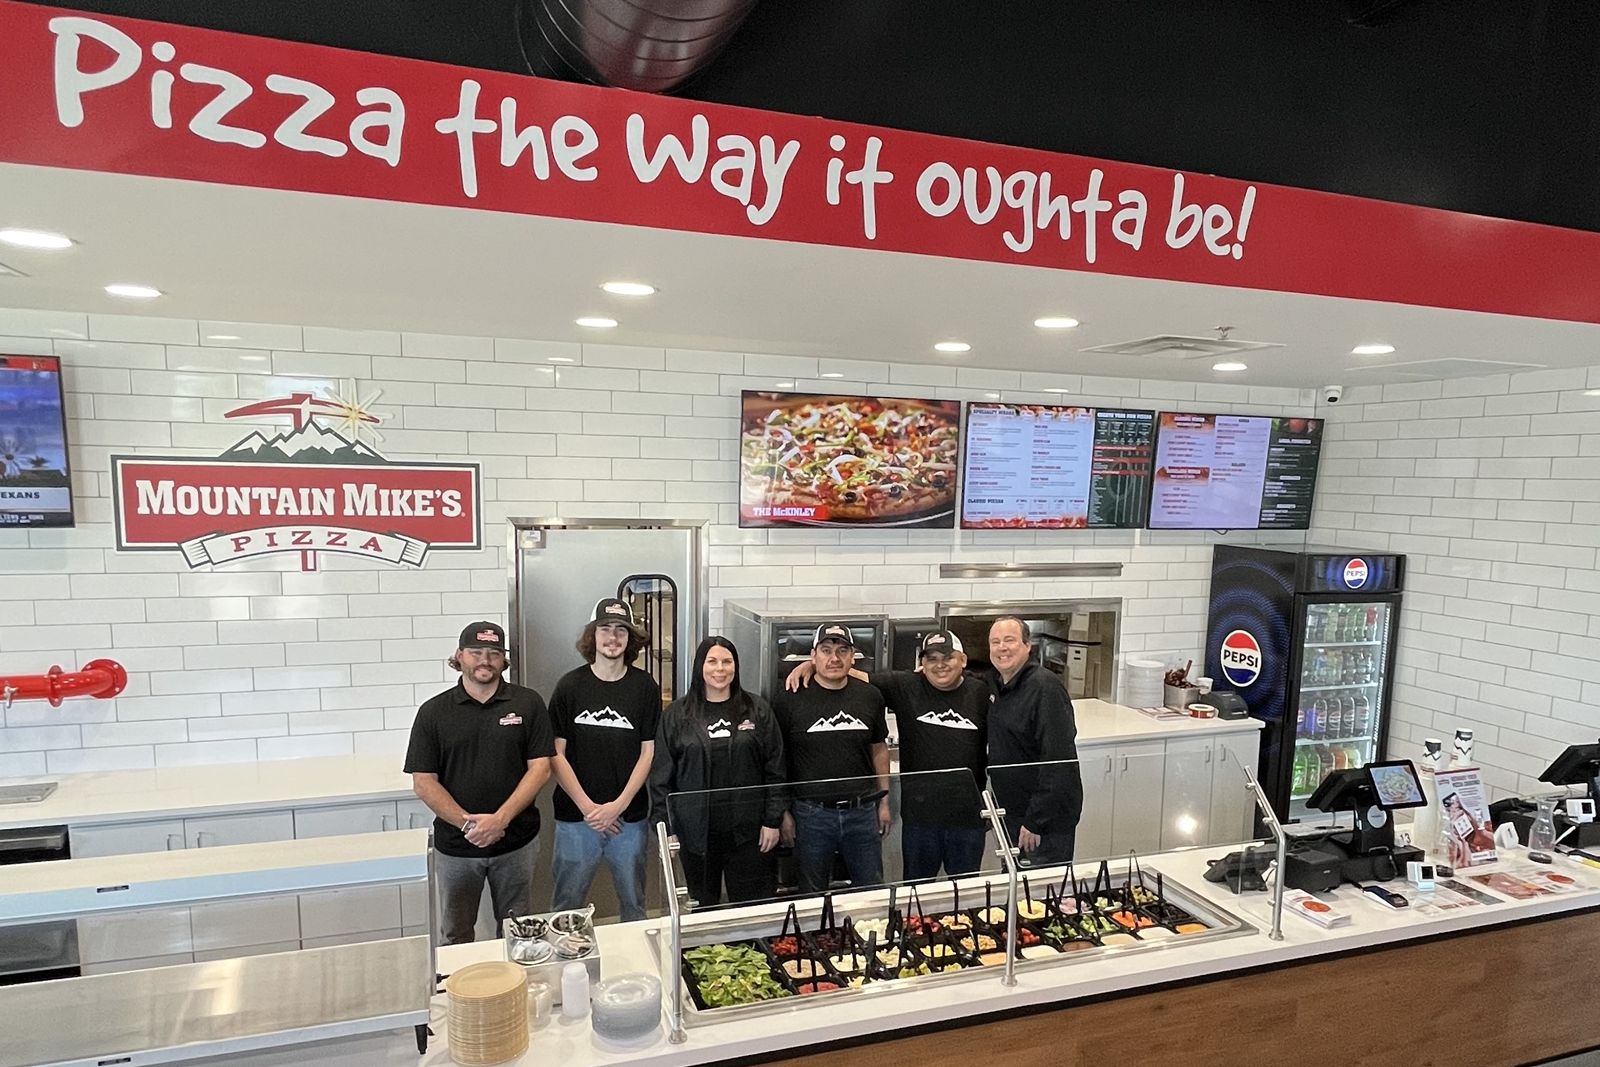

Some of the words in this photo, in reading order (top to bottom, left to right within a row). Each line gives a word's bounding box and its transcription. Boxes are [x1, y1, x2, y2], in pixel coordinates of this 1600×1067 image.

[49, 17, 405, 167] Pizza
[435, 80, 599, 197] the
[627, 113, 801, 226] way
[827, 135, 894, 240] it
[917, 162, 1147, 264] oughta
[1166, 173, 1257, 260] be!
[0, 491, 40, 499] EXANS
[135, 479, 335, 517] MOUNTAIN
[342, 482, 463, 518] MIKE'S
[752, 507, 771, 517] THE
[773, 507, 815, 517] McKINLEY
[230, 530, 384, 553] PIZZA
[1346, 569, 1366, 578] PEPSI
[1223, 649, 1259, 669] PEPSI
